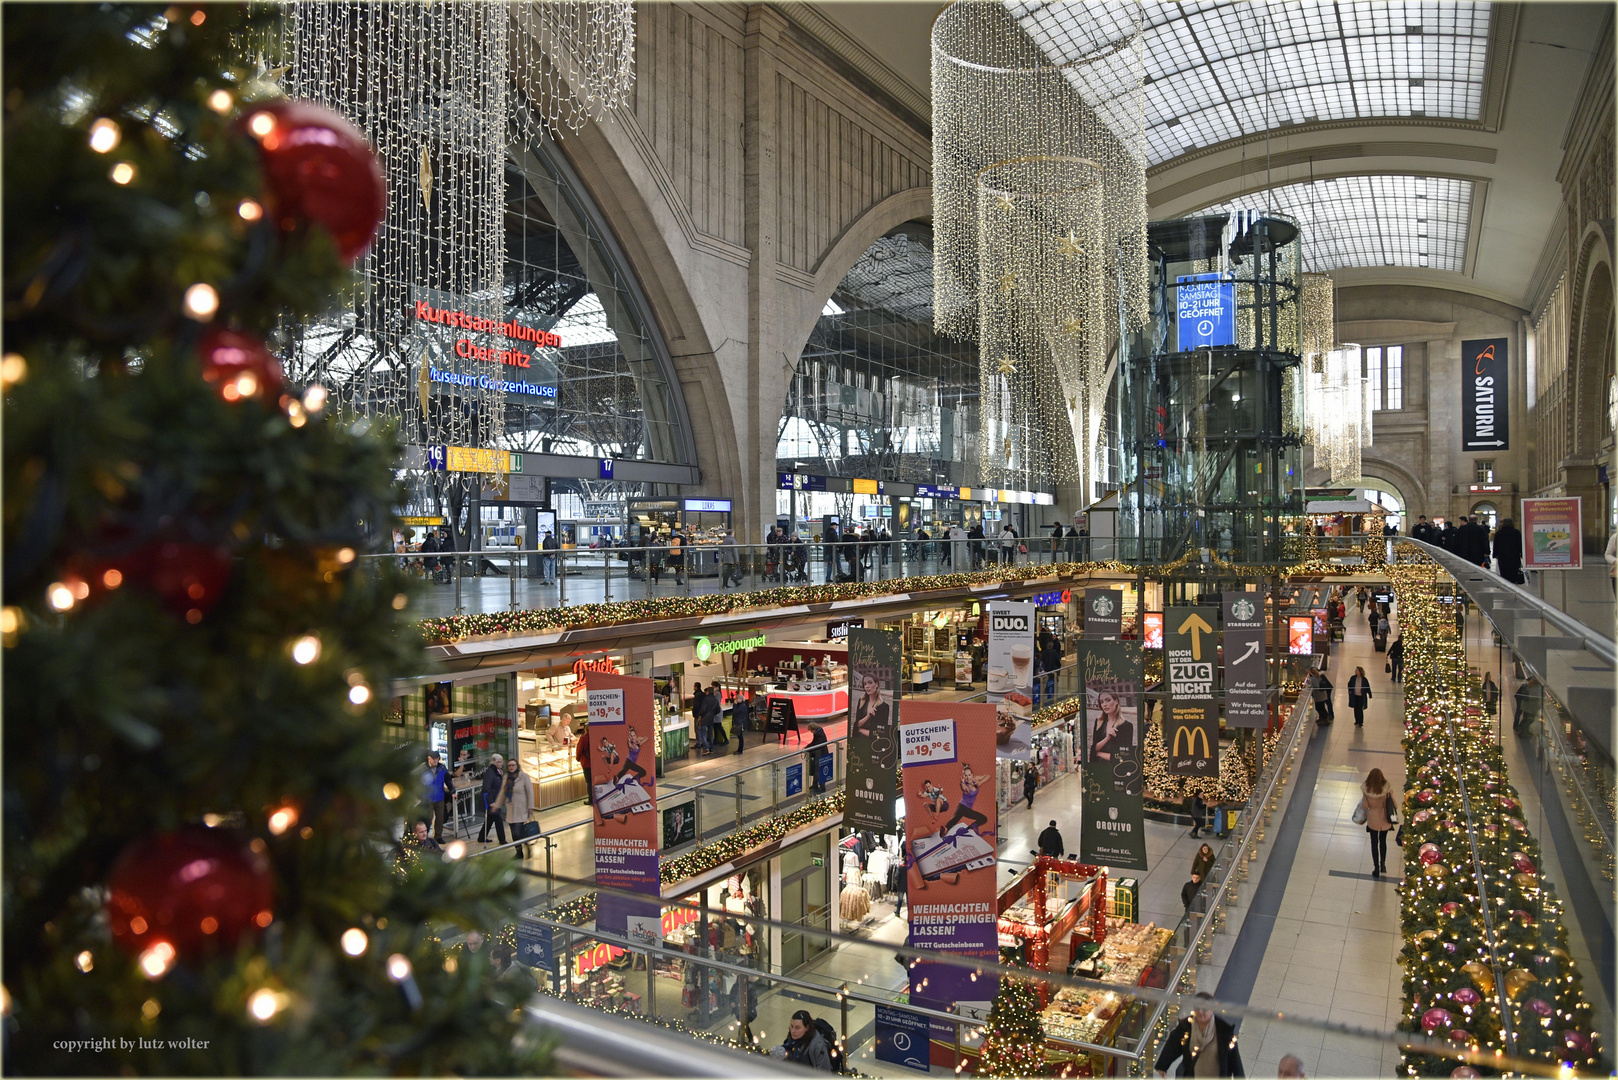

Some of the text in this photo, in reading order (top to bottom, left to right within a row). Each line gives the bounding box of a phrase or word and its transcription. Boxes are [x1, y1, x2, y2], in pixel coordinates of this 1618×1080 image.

[1180, 290, 1217, 301] SAMSTAG
[1202, 299, 1220, 308] UHR
[1180, 307, 1225, 319] GEÖFFNET
[416, 299, 562, 348] Kunstsammlungen
[430, 366, 477, 388] Museum
[1475, 376, 1495, 437] SATURN
[428, 445, 442, 460] 16
[603, 460, 613, 471] 17
[795, 475, 801, 488] S
[802, 475, 809, 484] 18
[994, 617, 1028, 630] DUO.
[831, 622, 848, 638] sushi
[713, 634, 767, 655] asiagourmet
[1172, 665, 1210, 680] ZUG
[1171, 682, 1212, 694] NICHT
[1172, 707, 1204, 715] Gegenüber
[905, 725, 950, 736] GUTSCHEIN-
[906, 735, 931, 744] BOXEN
[855, 789, 884, 801] OROVIVO
[1096, 820, 1132, 832] OROVIVO
[595, 838, 648, 847] WEIHNACHTEN
[595, 847, 656, 856] EINEN SPRINGEN
[595, 855, 625, 864] LASSEN!
[913, 902, 990, 914] WEIHNACHTEN
[913, 914, 997, 925] EINEN SPRINGEN
[913, 926, 956, 936] LASSEN!
[933, 941, 984, 949] Gutscheinboxen
